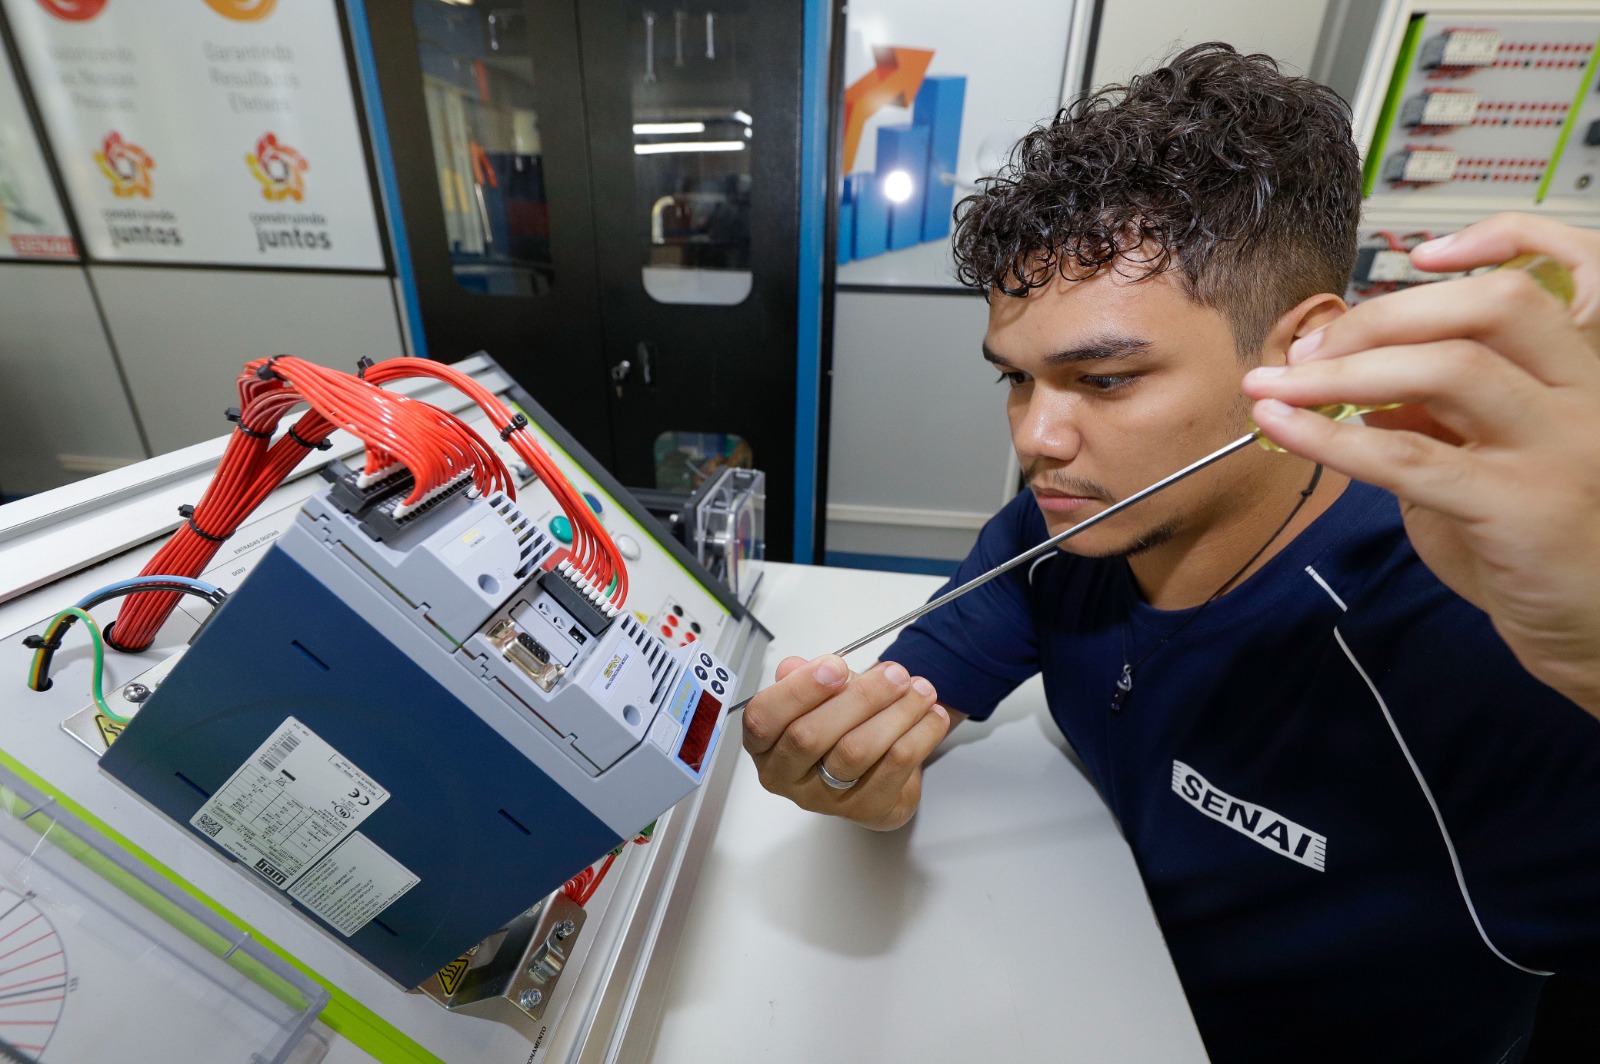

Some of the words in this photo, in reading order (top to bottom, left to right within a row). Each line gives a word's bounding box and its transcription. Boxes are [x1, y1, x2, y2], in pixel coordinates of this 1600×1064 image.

[109, 221, 184, 249] juntos
[255, 226, 334, 253] juntos
[233, 539, 261, 555] ENTRADAS
[259, 529, 280, 542] DIGITAIS
[1181, 773, 1312, 860] SENAI
